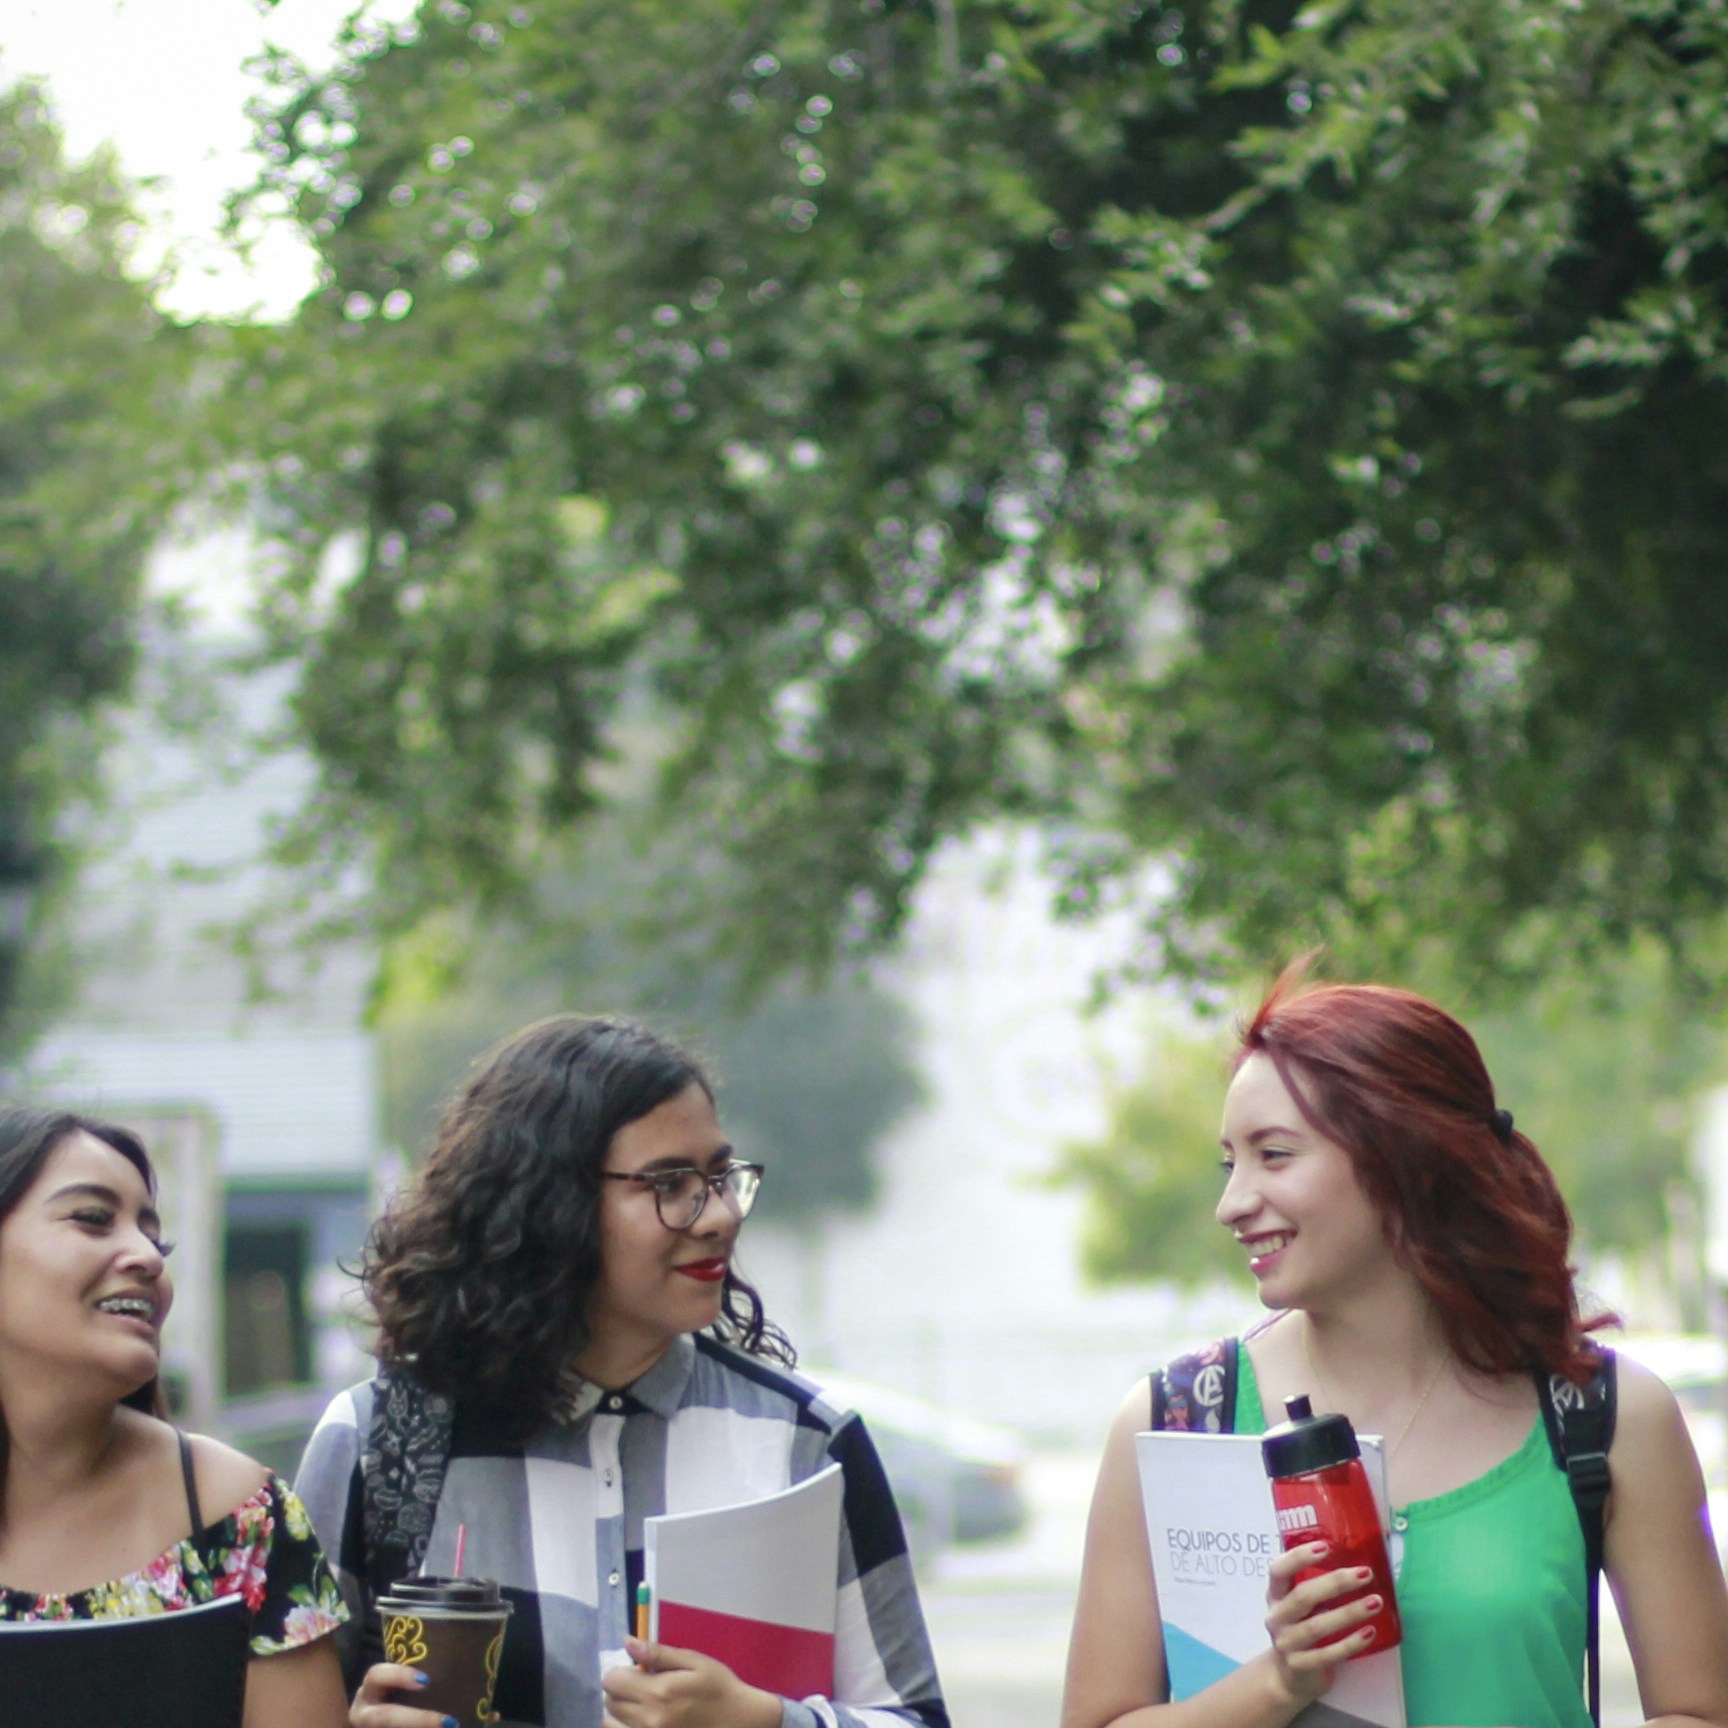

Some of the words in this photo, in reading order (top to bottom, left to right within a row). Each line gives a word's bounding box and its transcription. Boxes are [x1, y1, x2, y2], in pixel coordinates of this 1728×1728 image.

[1167, 1528, 1242, 1553] EQUIPOS
[1247, 1533, 1271, 1554] DE
[1170, 1551, 1190, 1571] DE
[1196, 1554, 1237, 1575] ALTO
